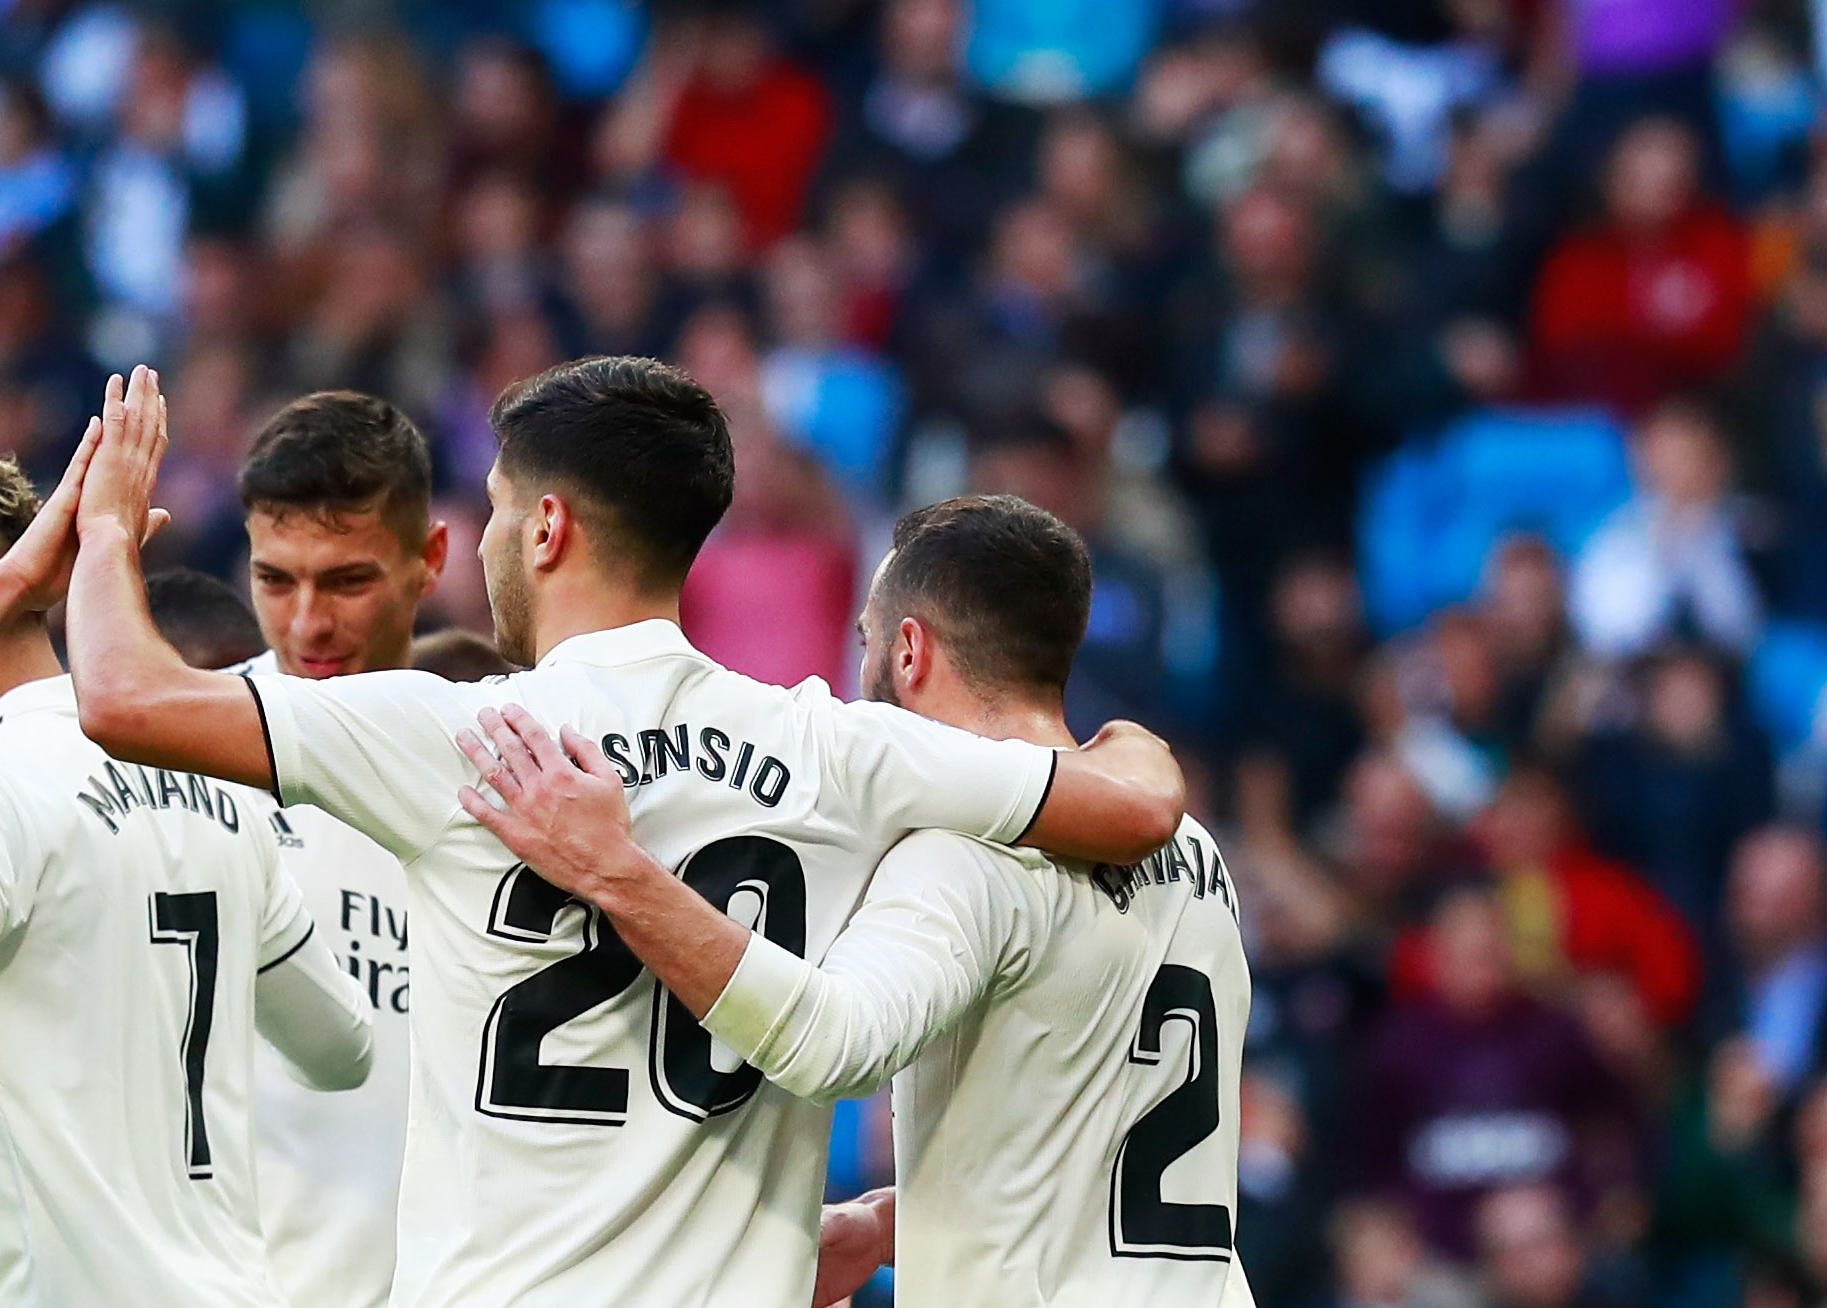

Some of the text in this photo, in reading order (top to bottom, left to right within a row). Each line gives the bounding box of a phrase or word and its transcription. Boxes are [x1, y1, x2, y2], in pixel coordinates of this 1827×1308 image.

[602, 724, 791, 808] SENSIO
[148, 890, 220, 1180] 7
[340, 888, 409, 951] Fly
[474, 835, 807, 1126] 20
[1108, 963, 1233, 1264] 2
